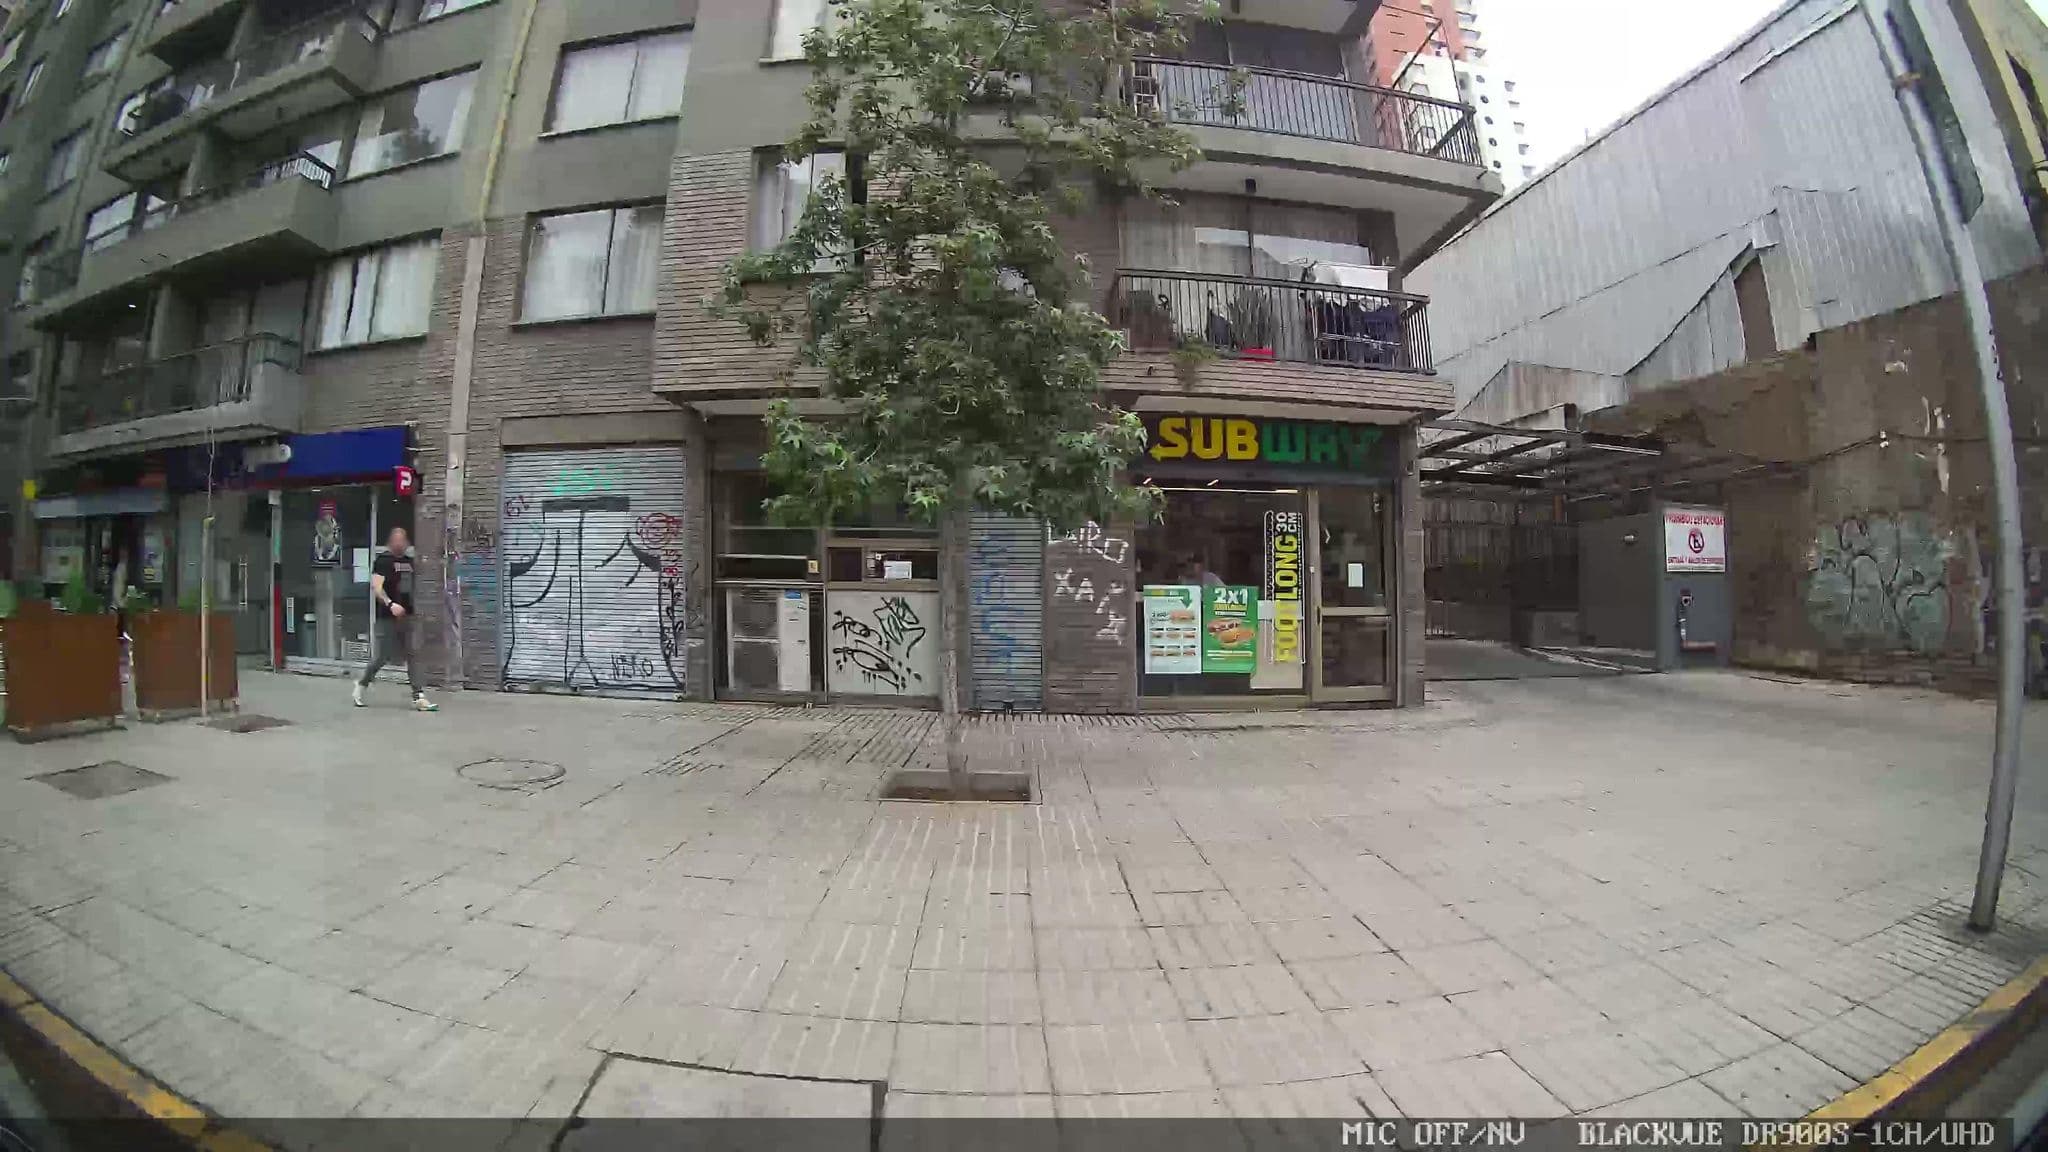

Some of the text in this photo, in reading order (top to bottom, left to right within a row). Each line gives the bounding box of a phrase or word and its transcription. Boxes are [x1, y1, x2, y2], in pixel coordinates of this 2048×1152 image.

[1150, 416, 1382, 469] SUBWAY
[1275, 511, 1287, 533] 30
[1287, 511, 1297, 533] CM
